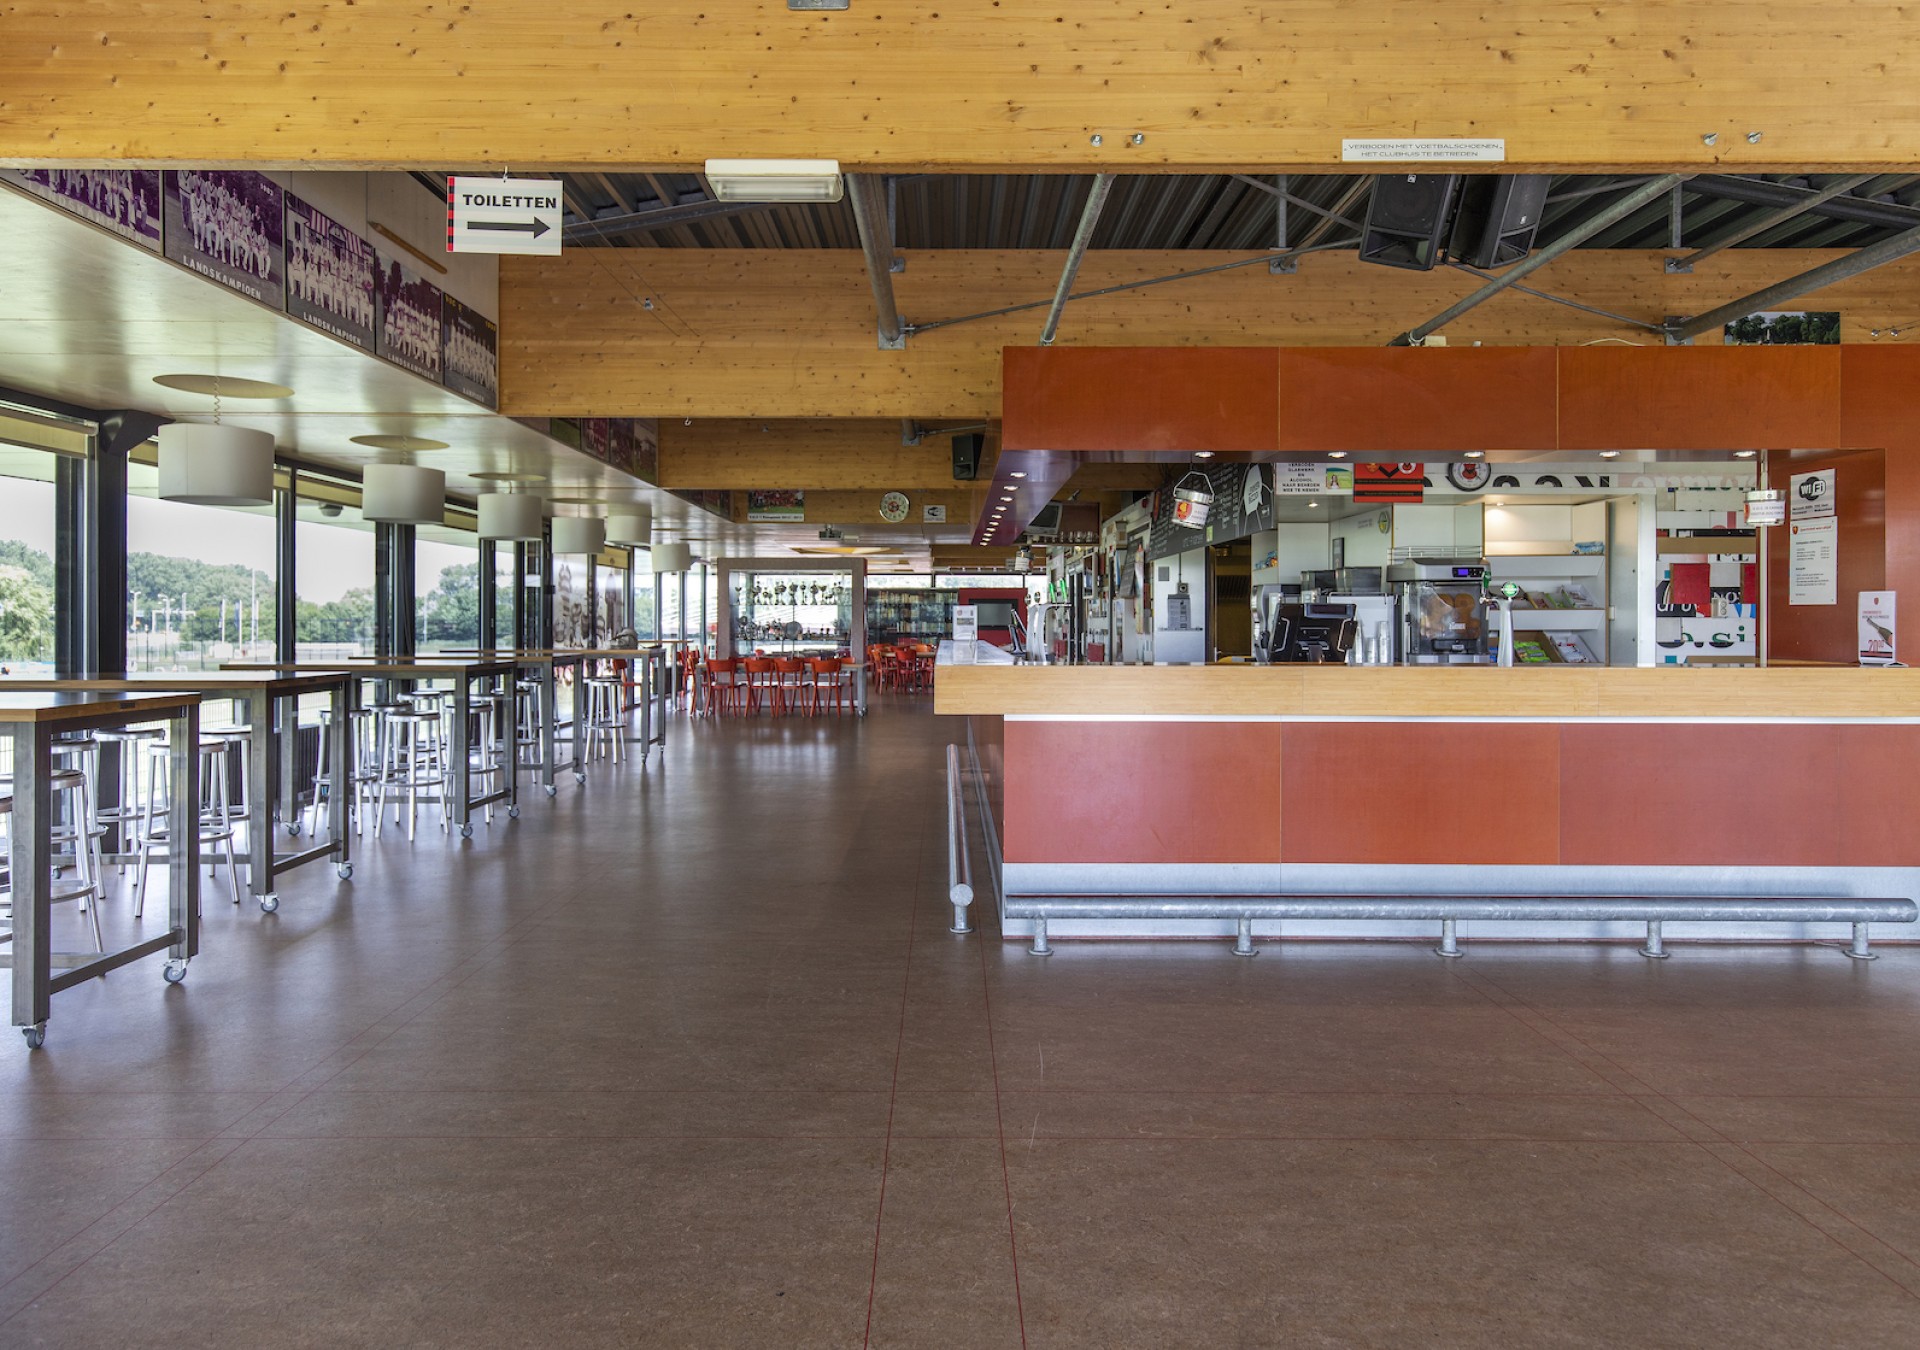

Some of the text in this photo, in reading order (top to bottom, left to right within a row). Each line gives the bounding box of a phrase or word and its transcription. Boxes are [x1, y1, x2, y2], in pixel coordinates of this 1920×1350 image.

[462, 194, 557, 209] TOILETTEN
[182, 254, 261, 300] LANDSKAMPIOEN
[303, 311, 361, 346] LANDSKAMPIOEN
